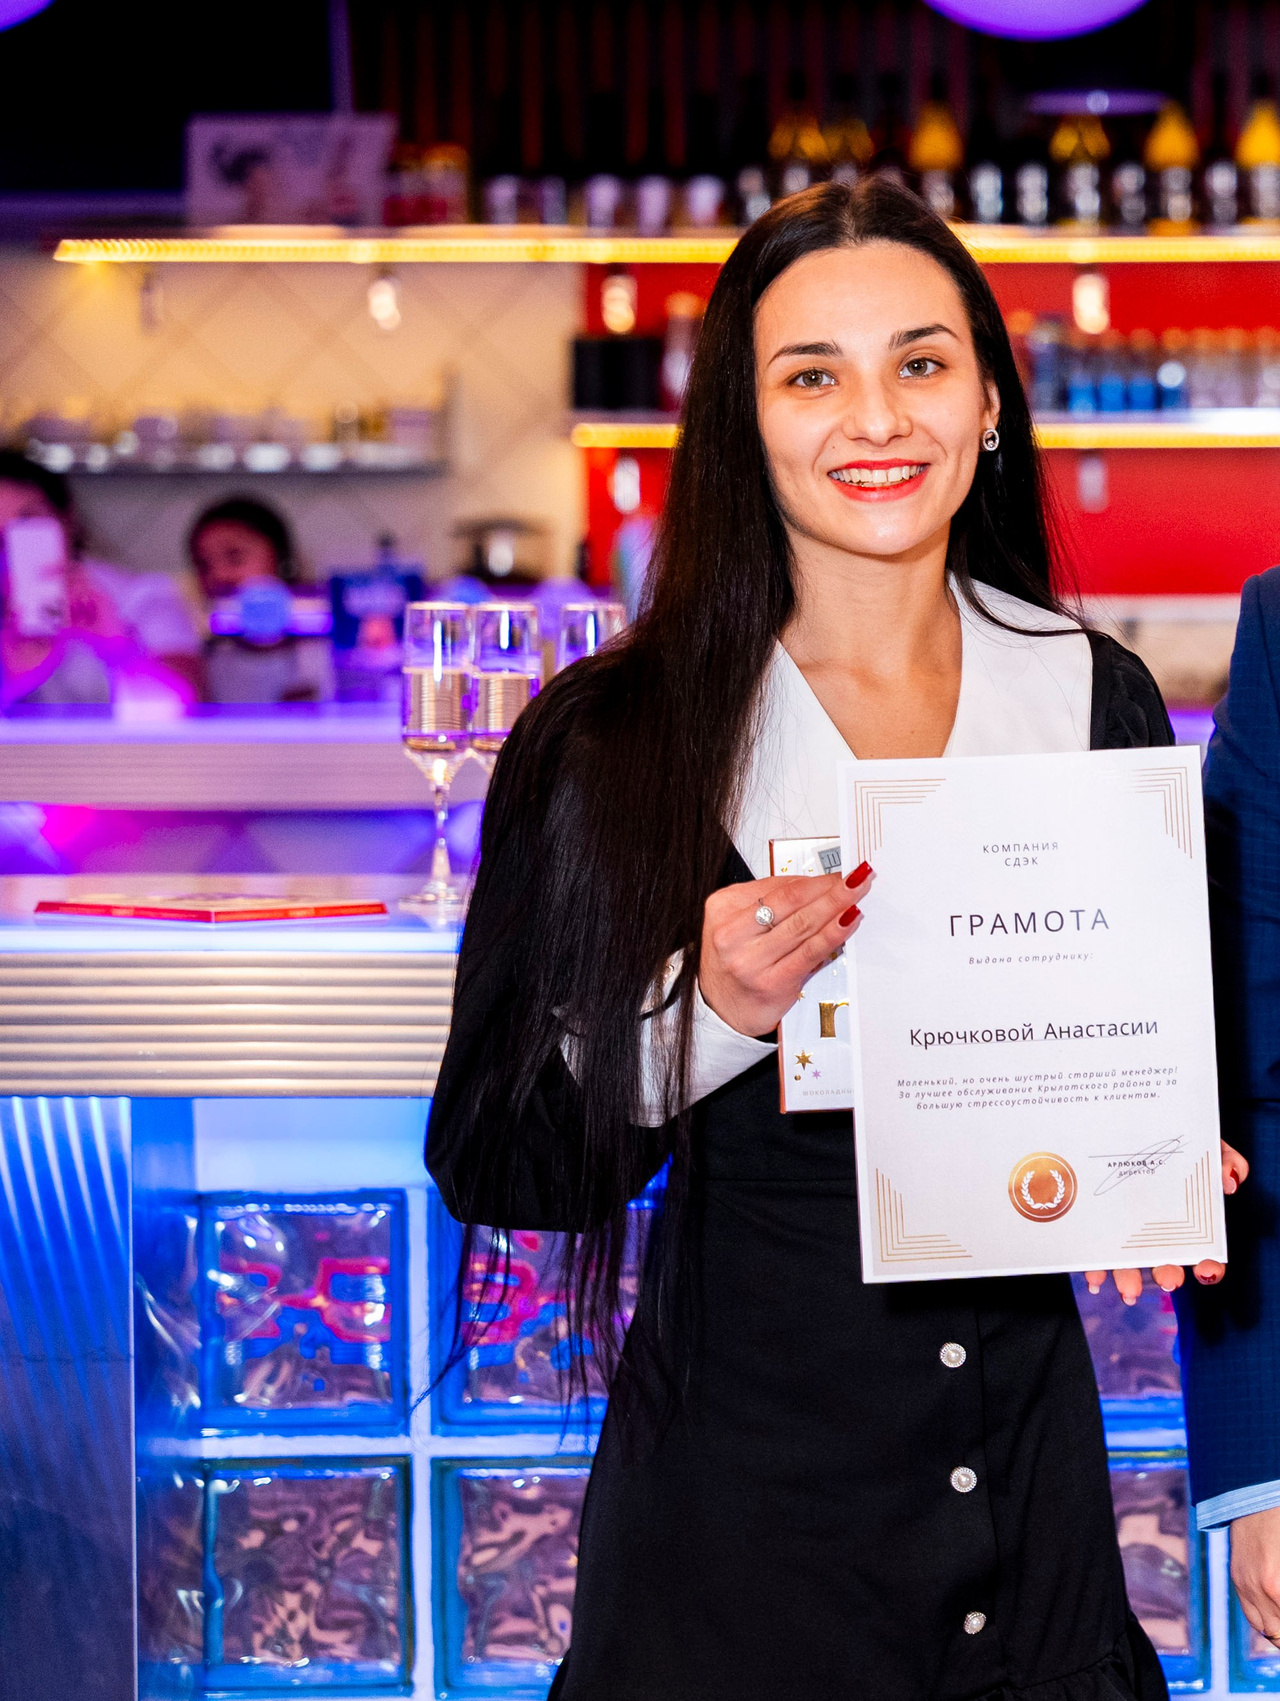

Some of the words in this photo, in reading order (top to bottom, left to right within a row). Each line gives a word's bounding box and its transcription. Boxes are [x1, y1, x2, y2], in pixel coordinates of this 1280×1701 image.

[982, 842, 1059, 853] КОМПАНИЯ
[1004, 857, 1039, 867] СДЭК
[949, 908, 1110, 937] ГРАМОТА
[969, 956, 1012, 965] Выдана
[1018, 952, 1094, 963] сотруднику:
[909, 1023, 1034, 1050] Крючковой
[1044, 1021, 1158, 1040] Анастасии
[897, 1077, 958, 1088] Маленький,
[1014, 1072, 1063, 1081] шустрый
[1068, 1069, 1117, 1079] старший
[1121, 1065, 1178, 1077] менеджер!
[899, 1091, 911, 1099] За
[914, 1090, 953, 1100] лучшее
[957, 1086, 1033, 1098] обслуживание
[1038, 1082, 1108, 1093] Крылатского
[1112, 1079, 1151, 1090] района
[917, 1101, 963, 1111] большую
[968, 1096, 1089, 1109] стрессоустойчивость
[1104, 1091, 1160, 1101] клиентам.
